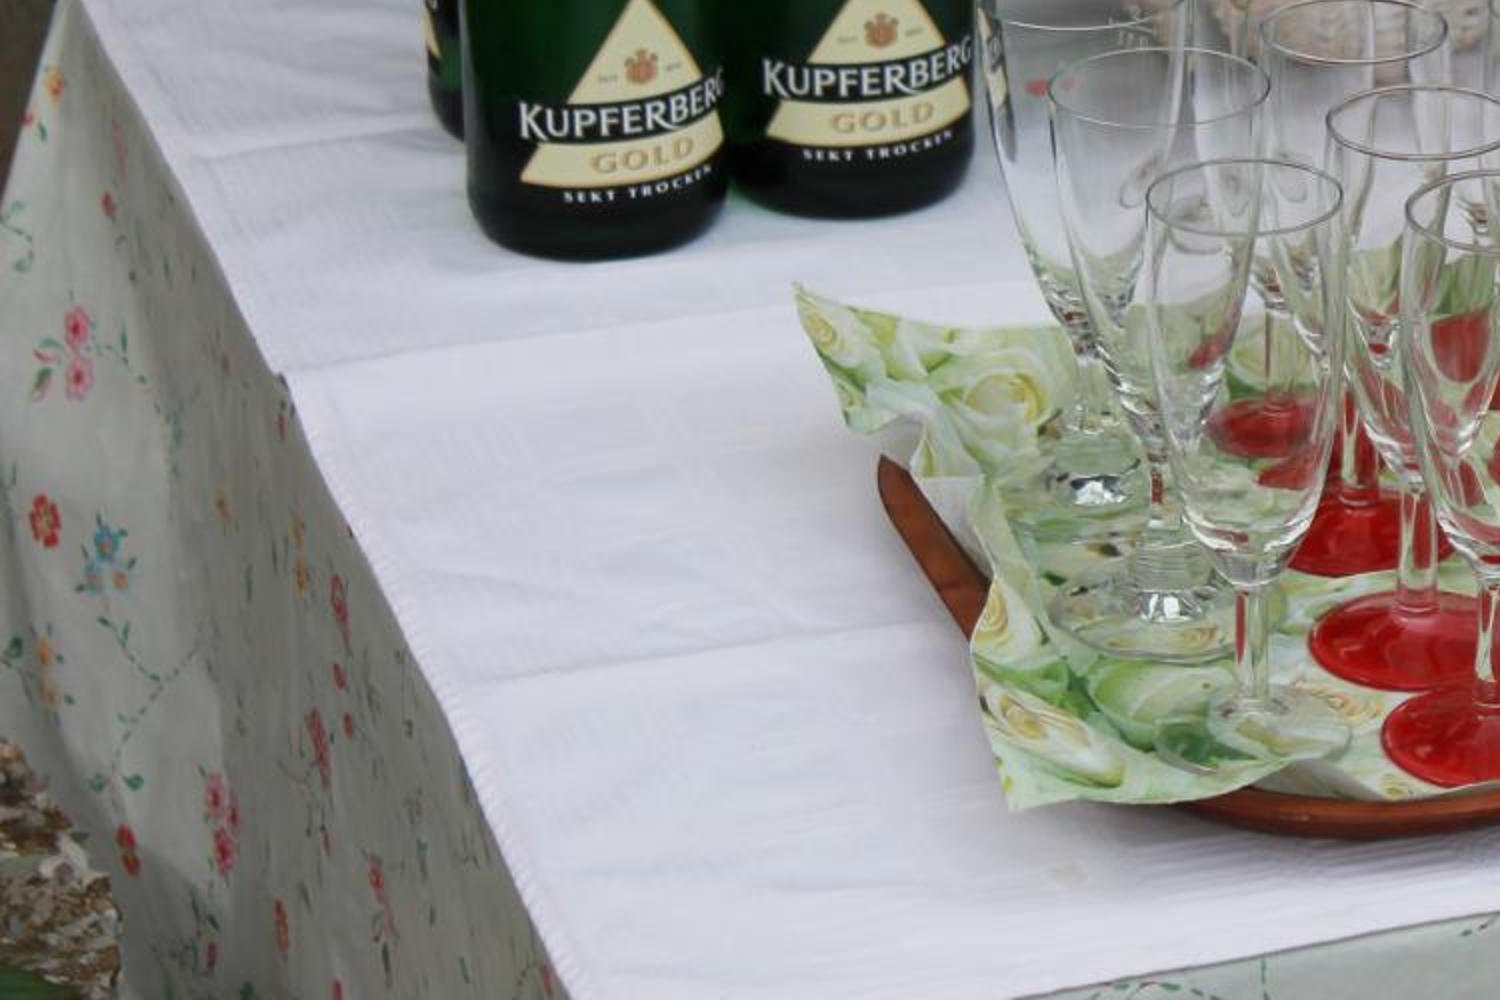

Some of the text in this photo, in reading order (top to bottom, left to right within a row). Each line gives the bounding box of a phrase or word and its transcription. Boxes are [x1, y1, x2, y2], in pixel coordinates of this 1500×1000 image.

[761, 34, 973, 100] KUPFERBERG
[829, 102, 935, 134] GOLD
[590, 138, 695, 174] GOLD
[802, 130, 953, 162] SEKT TROCKEN
[563, 165, 713, 204] SEKT TROCKEN
